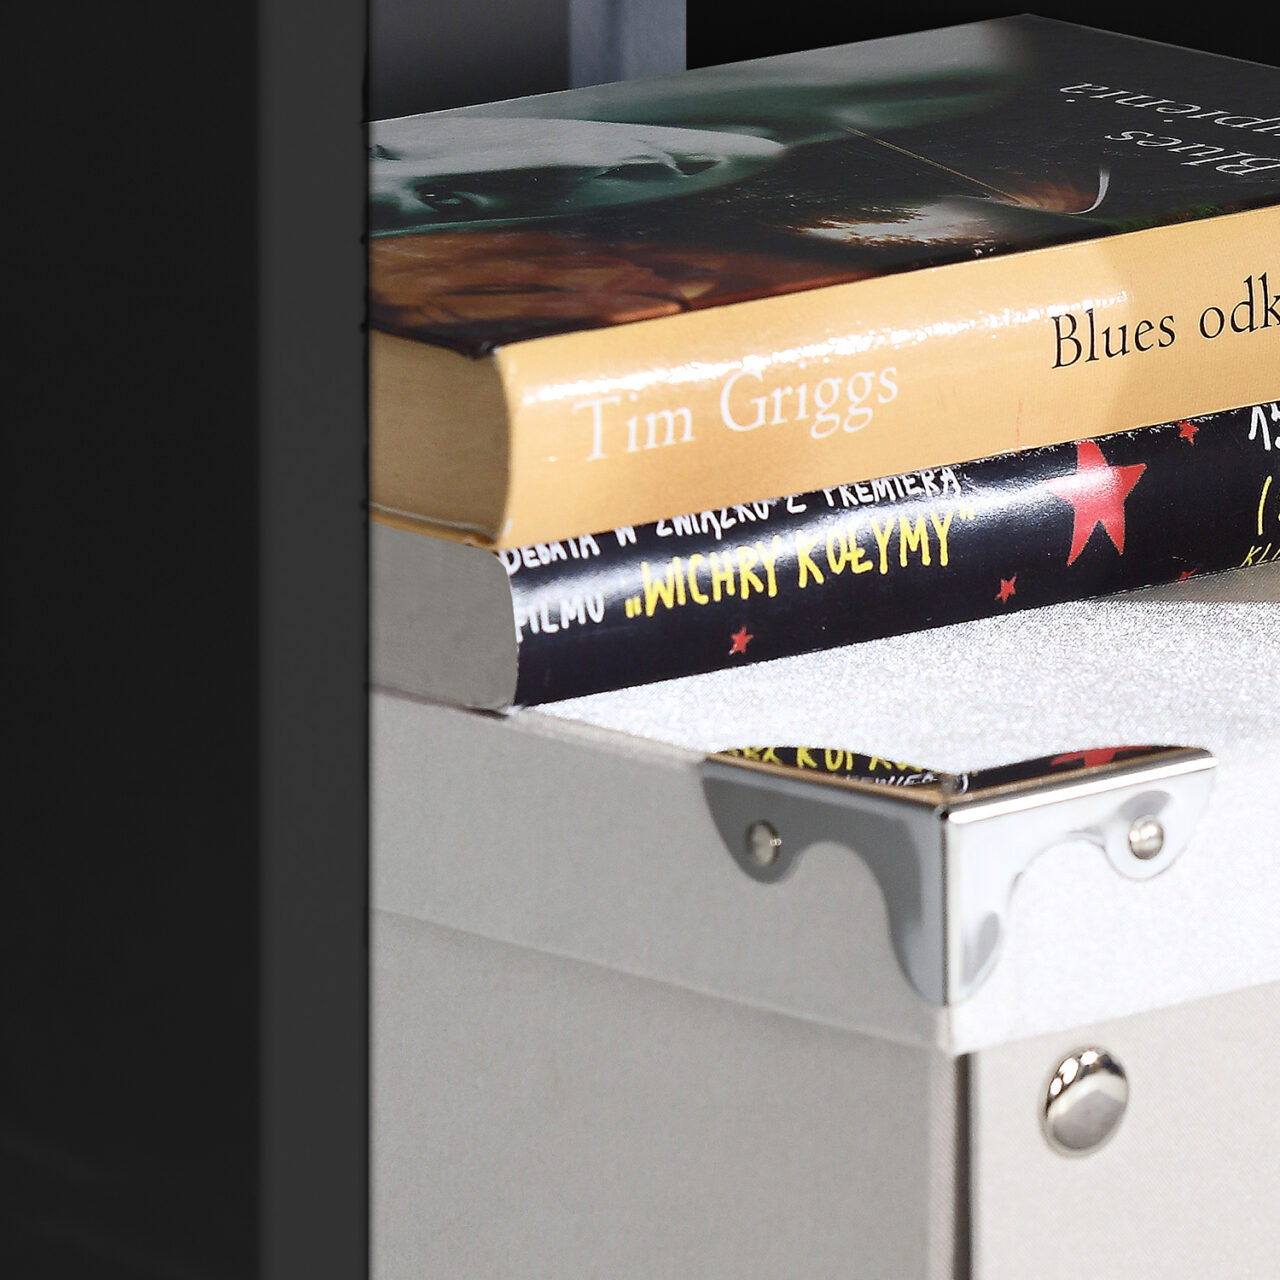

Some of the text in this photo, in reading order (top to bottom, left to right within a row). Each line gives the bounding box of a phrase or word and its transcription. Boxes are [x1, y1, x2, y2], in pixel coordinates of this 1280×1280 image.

[1051, 308, 1176, 369] Blues
[572, 359, 899, 462] Tim Griggs
